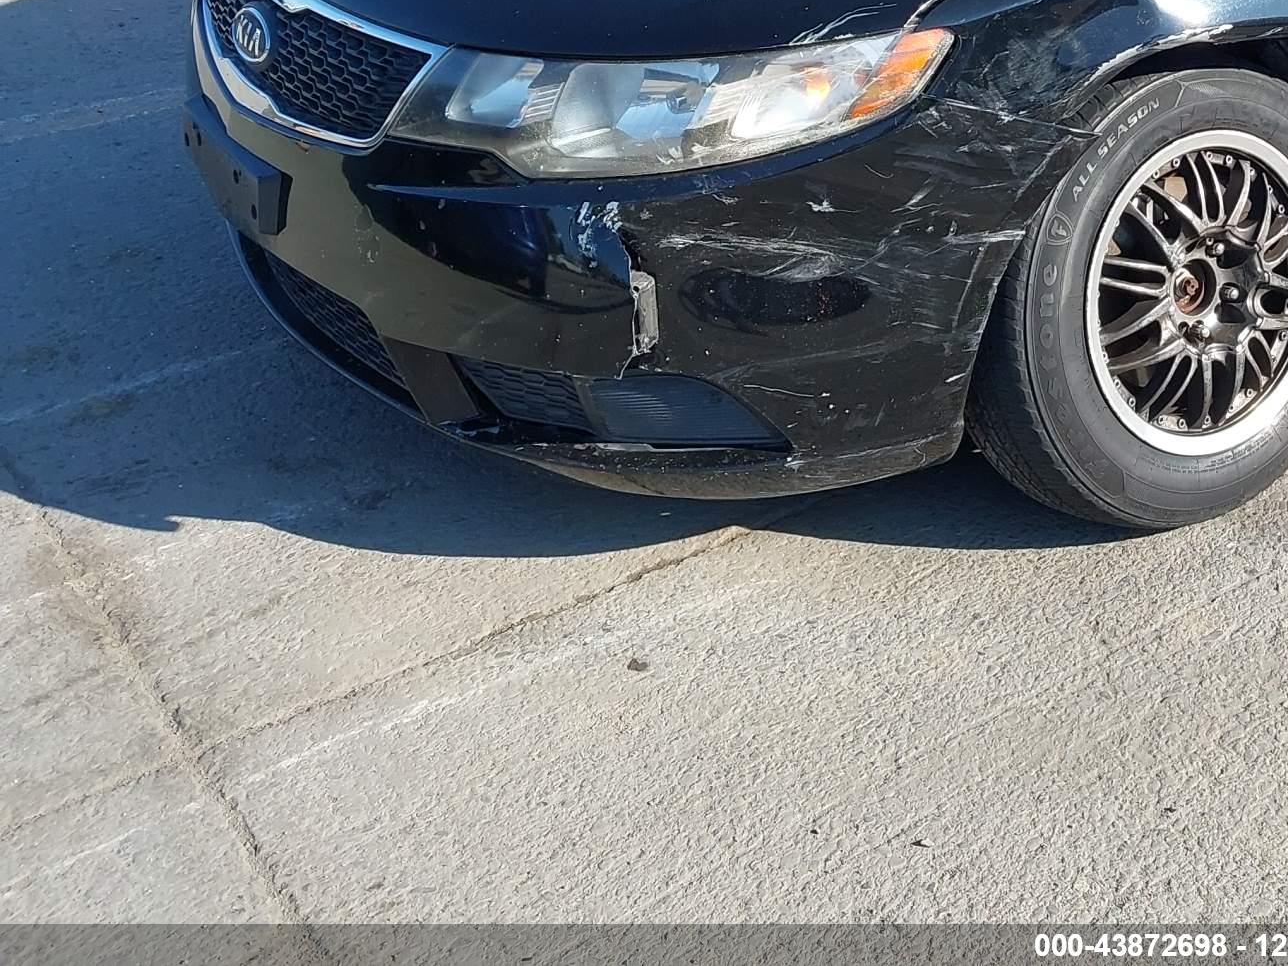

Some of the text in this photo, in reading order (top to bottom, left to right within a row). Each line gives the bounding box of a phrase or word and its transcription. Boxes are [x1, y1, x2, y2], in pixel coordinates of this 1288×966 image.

[235, 15, 262, 56] KIA
[1072, 97, 1160, 202] ALL SEASON
